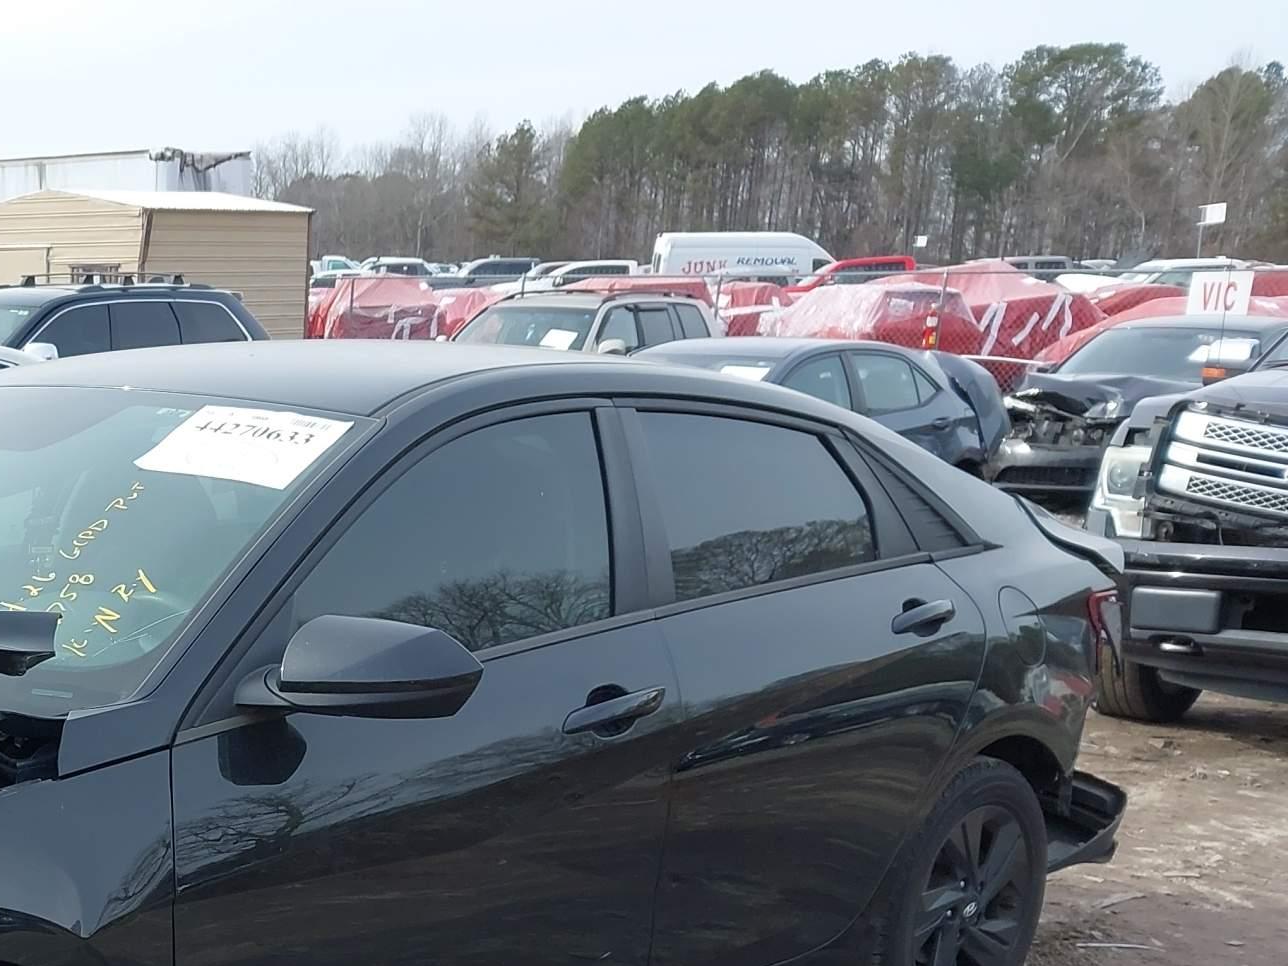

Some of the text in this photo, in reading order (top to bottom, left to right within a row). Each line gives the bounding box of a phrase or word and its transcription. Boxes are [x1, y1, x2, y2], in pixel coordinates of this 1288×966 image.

[682, 256, 798, 274] JUNK REMOVAL
[1203, 280, 1238, 311] VIC
[195, 420, 315, 445] 44270633
